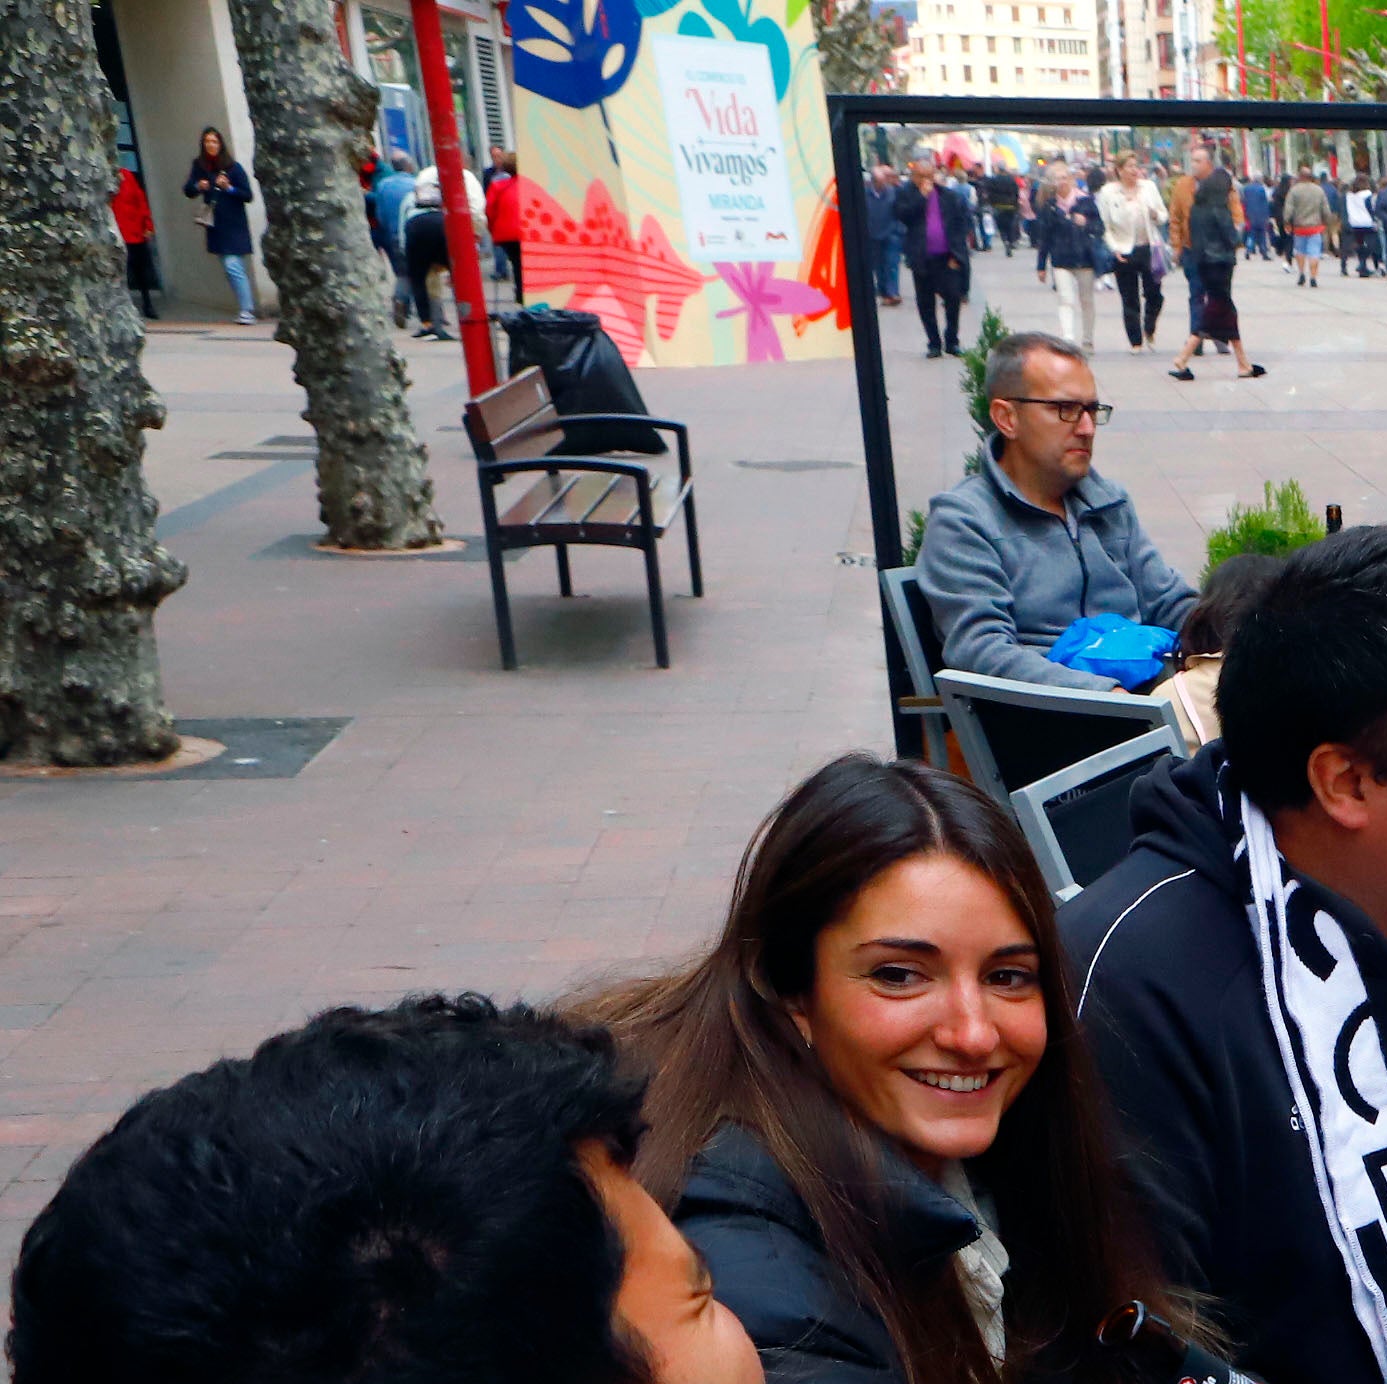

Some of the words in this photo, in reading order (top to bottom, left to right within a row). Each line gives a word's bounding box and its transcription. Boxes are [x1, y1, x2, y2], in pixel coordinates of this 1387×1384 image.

[685, 87, 759, 137] Vida
[680, 144, 777, 186] Vivamos
[708, 193, 766, 210] MIRANDA
